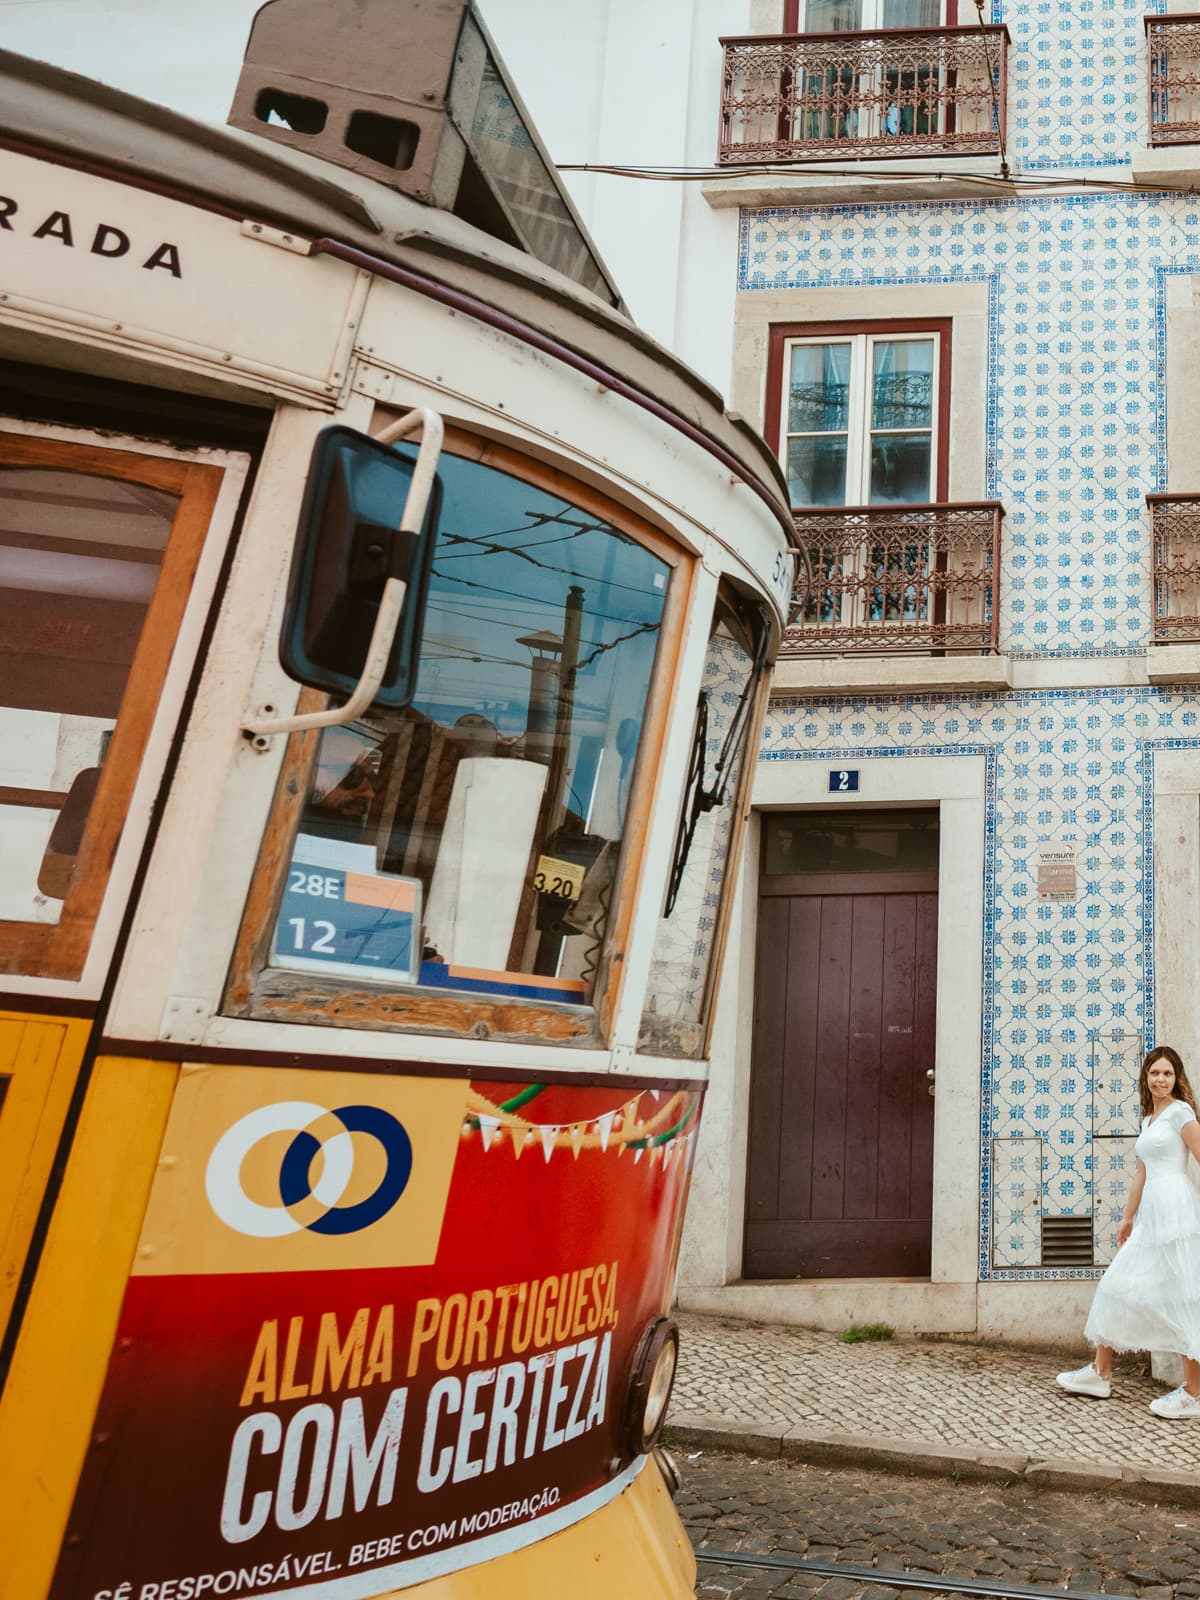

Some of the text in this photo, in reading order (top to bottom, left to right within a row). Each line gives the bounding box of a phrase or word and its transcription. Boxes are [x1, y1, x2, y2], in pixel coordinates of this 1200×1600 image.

[839, 771, 849, 790] 2
[288, 871, 341, 900] 28E
[288, 917, 337, 954] 12
[238, 1261, 620, 1407] ALMA PORTUGUESA,
[220, 1331, 612, 1544] COM CERTEZA
[139, 1551, 342, 1600] RESPONSÁVEL.
[348, 1534, 403, 1567] BEBE
[407, 1520, 457, 1550] COM
[459, 1486, 561, 1537] MODERAÇÃO.
